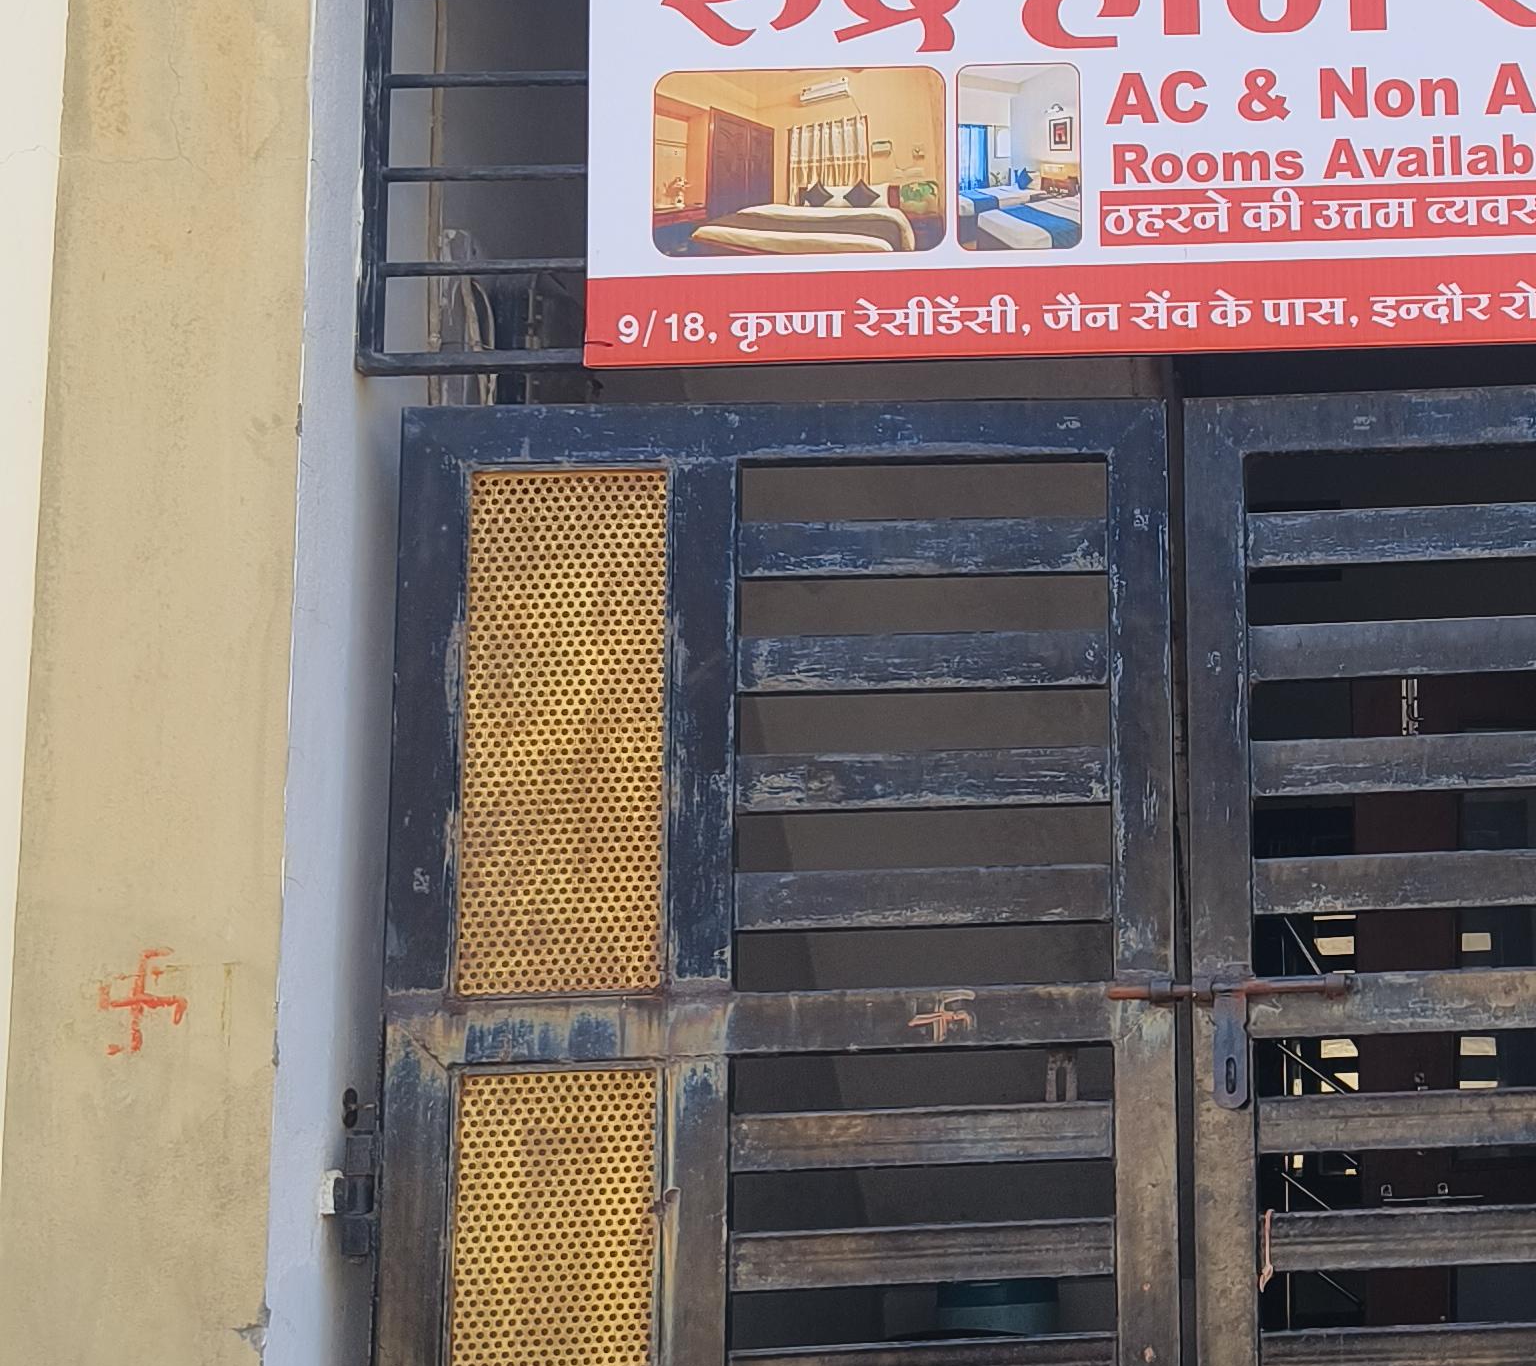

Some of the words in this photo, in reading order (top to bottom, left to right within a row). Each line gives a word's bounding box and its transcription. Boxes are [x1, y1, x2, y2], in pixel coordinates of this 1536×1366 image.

[1106, 70, 1209, 125] AC
[1237, 68, 1292, 122] &
[1319, 65, 1460, 119] Non
[1112, 143, 1306, 186] Rooms
[1102, 190, 1232, 237] ठहरने
[1240, 187, 1305, 233] की
[1312, 197, 1418, 230] उत्तम
[617, 309, 719, 349] 9/18,
[729, 309, 846, 353] कृष्णा
[1042, 291, 1122, 333] जैन
[1208, 288, 1254, 329] के
[1261, 295, 1361, 329] पास,
[1369, 281, 1492, 328] इन्दौर
